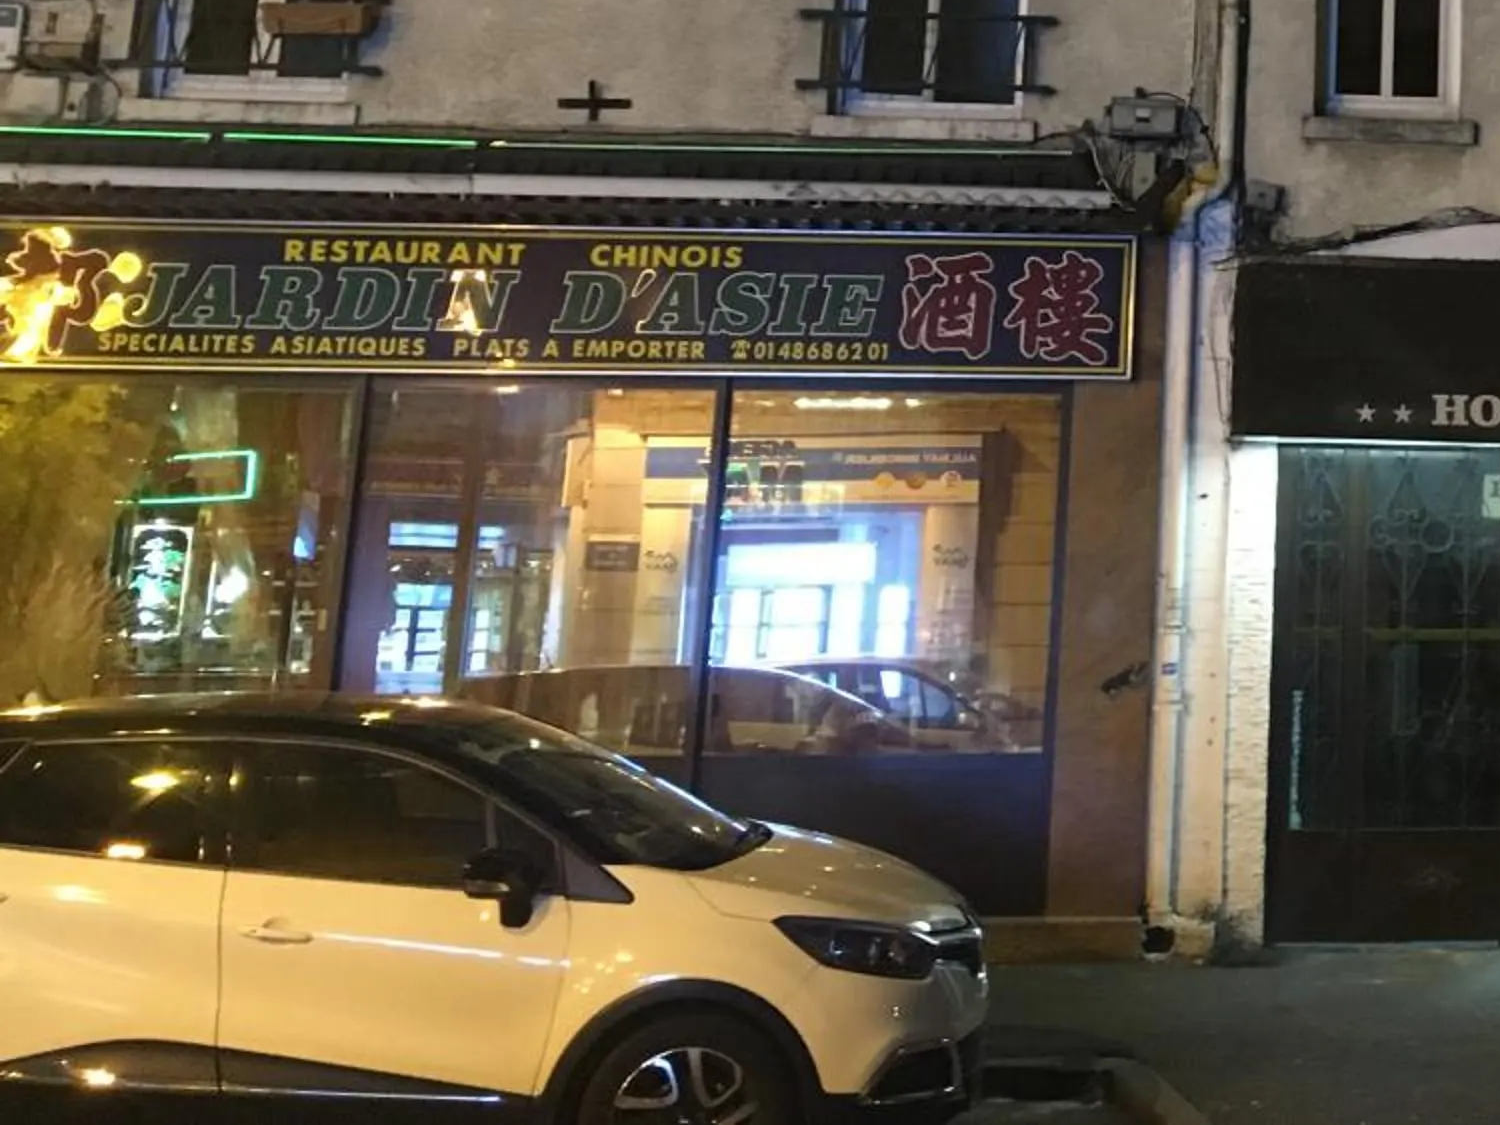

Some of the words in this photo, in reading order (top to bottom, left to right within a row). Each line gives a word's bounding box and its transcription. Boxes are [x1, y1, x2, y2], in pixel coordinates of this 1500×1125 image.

[284, 239, 526, 266] RESTAURANT
[590, 243, 744, 269] CHINOIS
[123, 262, 521, 334] JARDIN
[549, 268, 885, 337] D'ASIE
[899, 250, 1114, 366] 酒樓
[98, 331, 256, 355] SPECIALITES
[270, 334, 427, 358] ASIATIQUES
[453, 337, 530, 359] PLATS
[572, 339, 706, 360] EMPORTER
